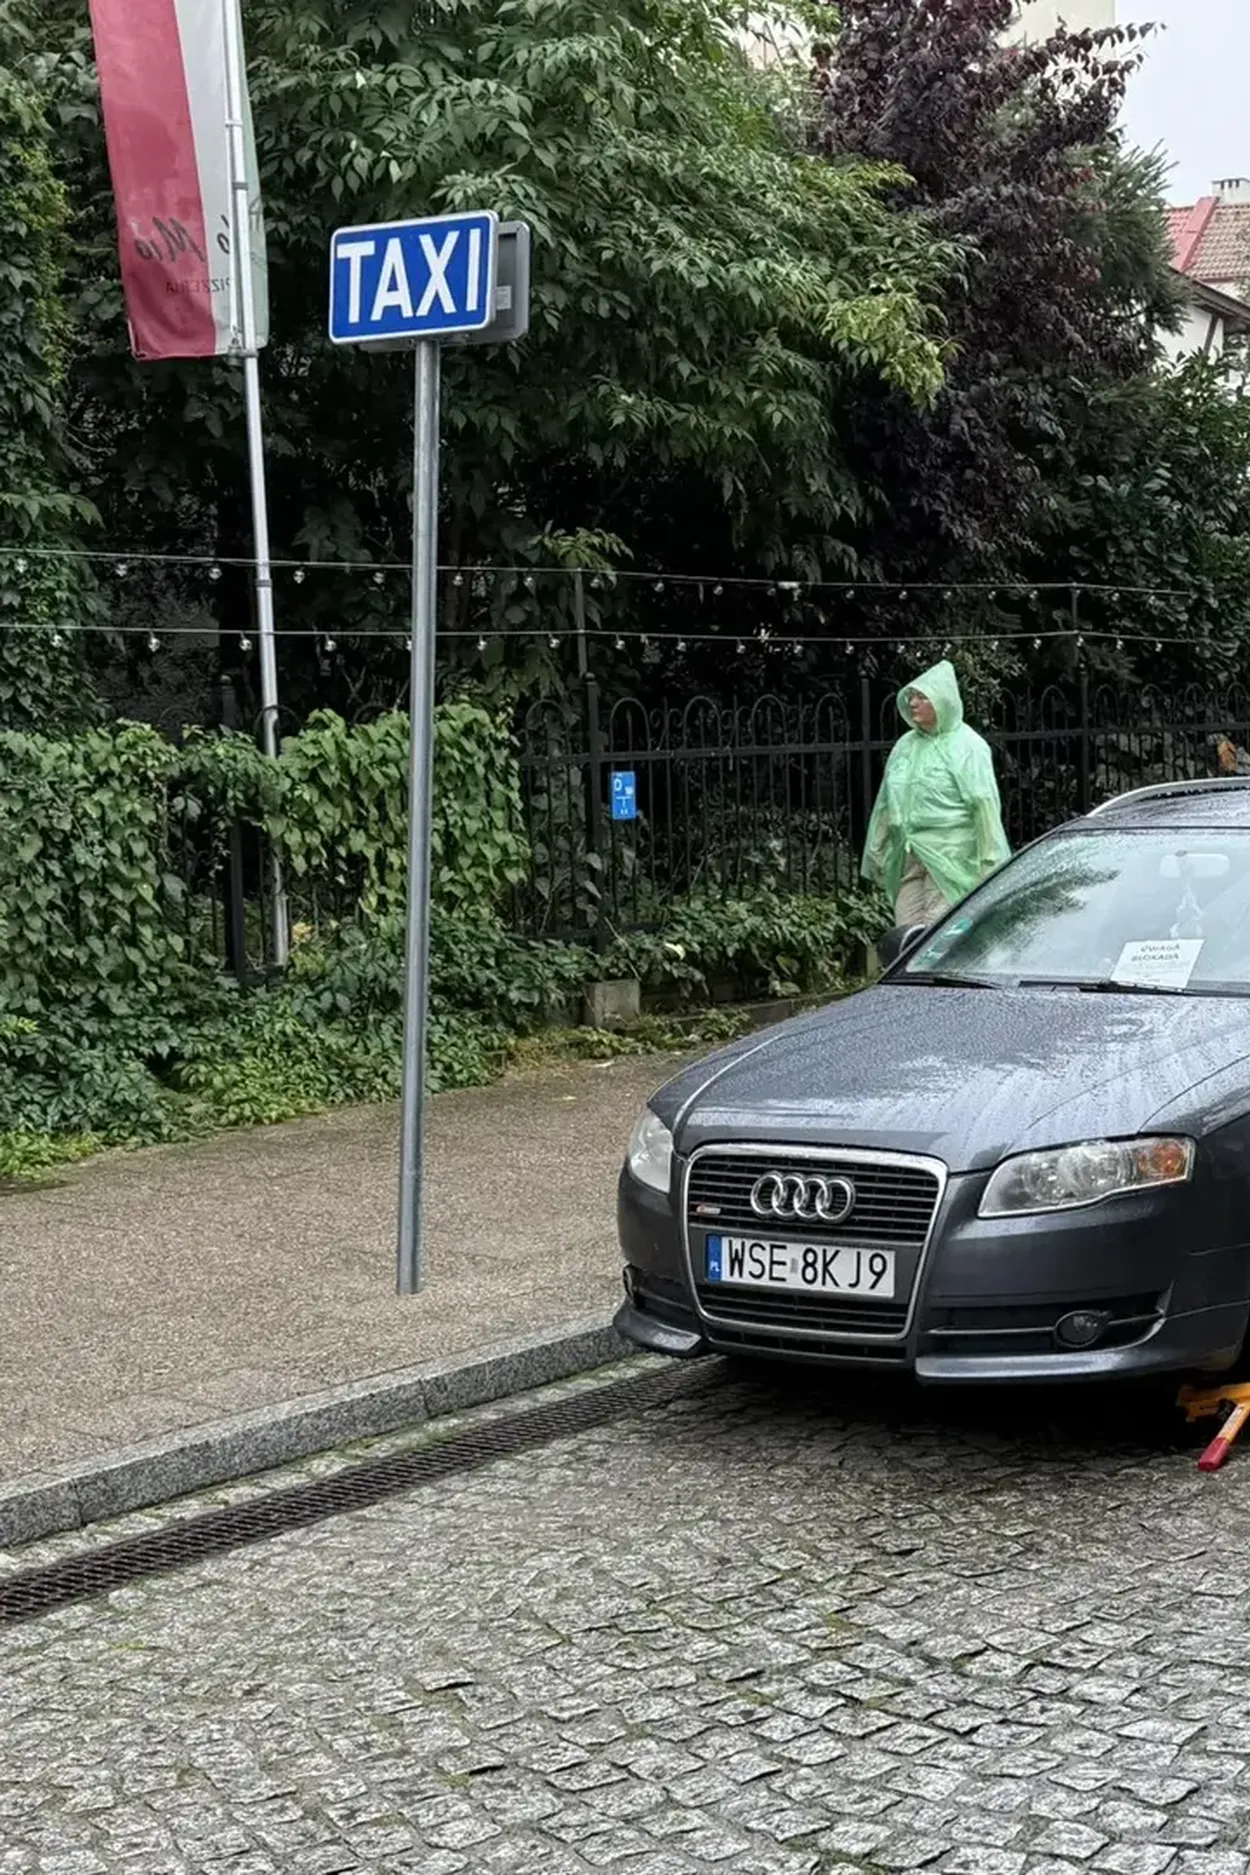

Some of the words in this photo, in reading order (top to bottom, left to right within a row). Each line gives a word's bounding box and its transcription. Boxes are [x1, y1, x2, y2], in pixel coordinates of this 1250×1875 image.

[337, 228, 482, 324] TAXI
[728, 1238, 788, 1282] WSE
[801, 1247, 888, 1290] 8KJ9
